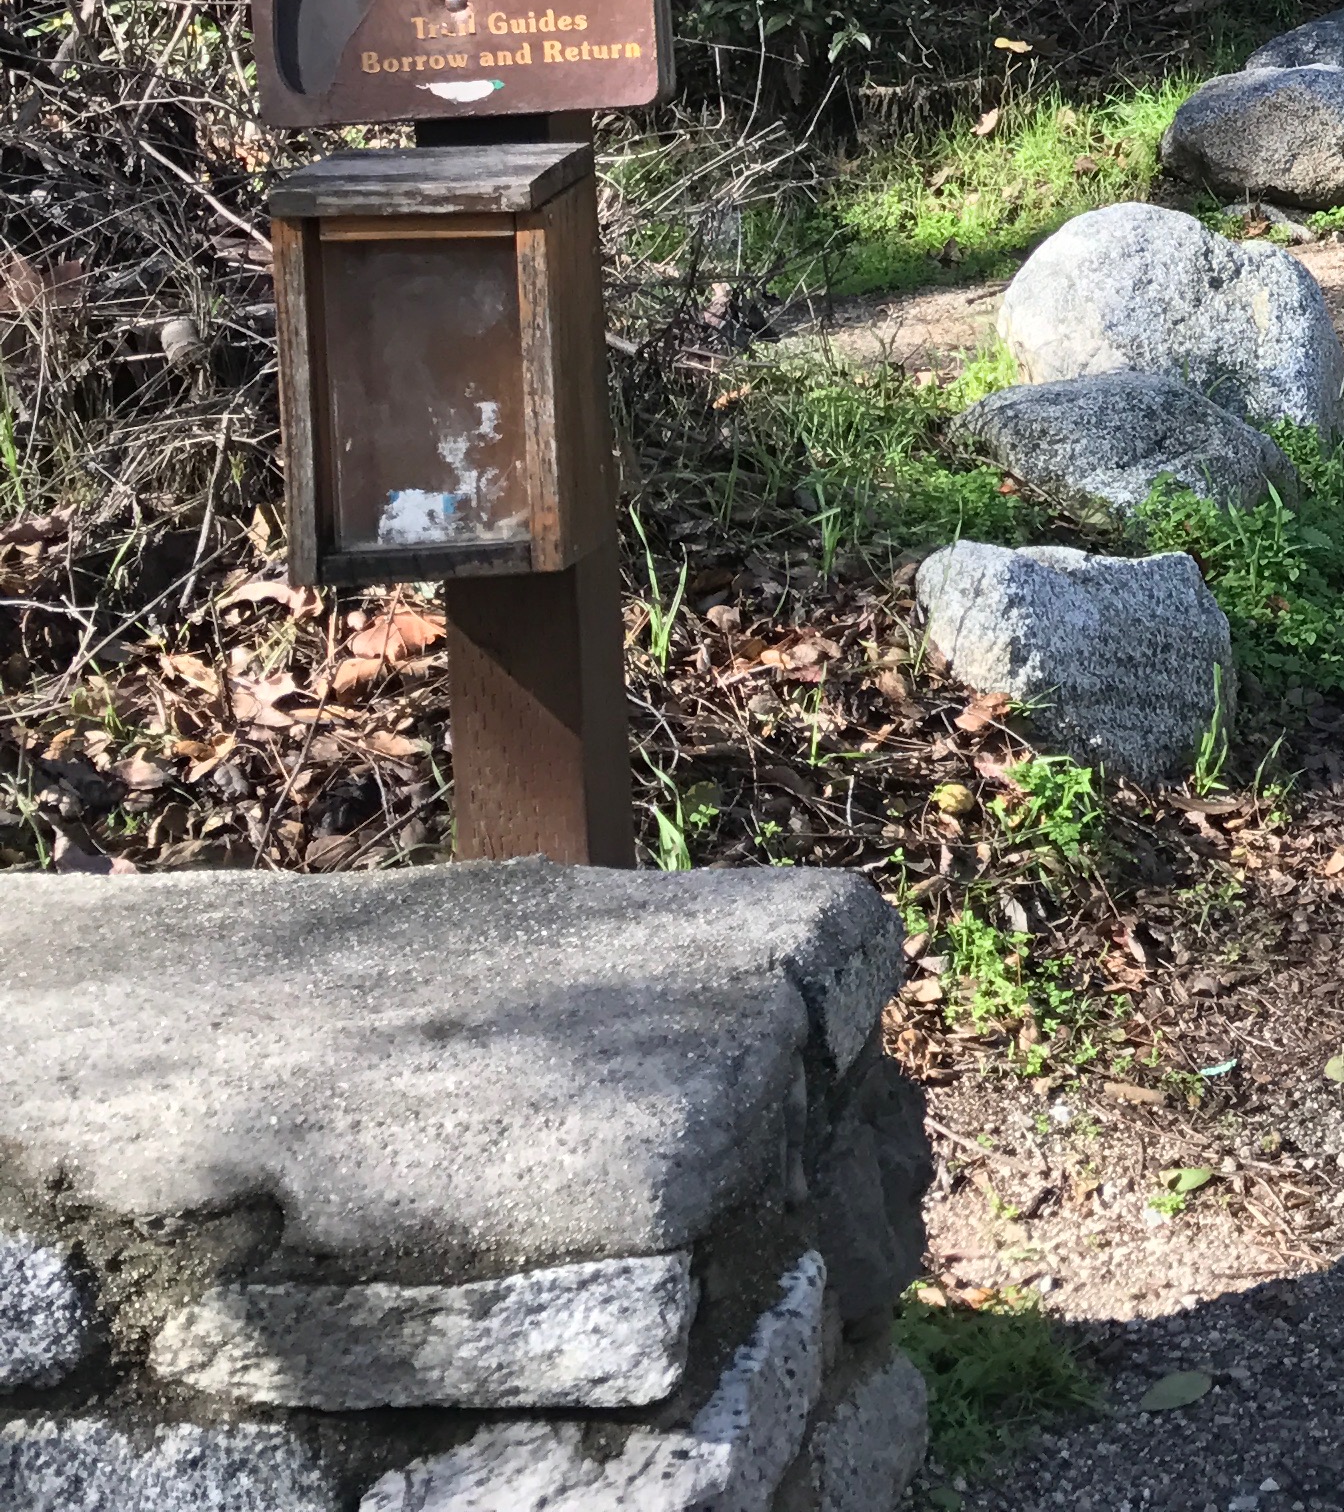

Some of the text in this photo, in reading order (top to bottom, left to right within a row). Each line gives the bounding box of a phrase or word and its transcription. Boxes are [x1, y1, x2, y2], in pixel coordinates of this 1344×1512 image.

[488, 9, 588, 35] Guides
[361, 41, 642, 74] Borrow and Return
